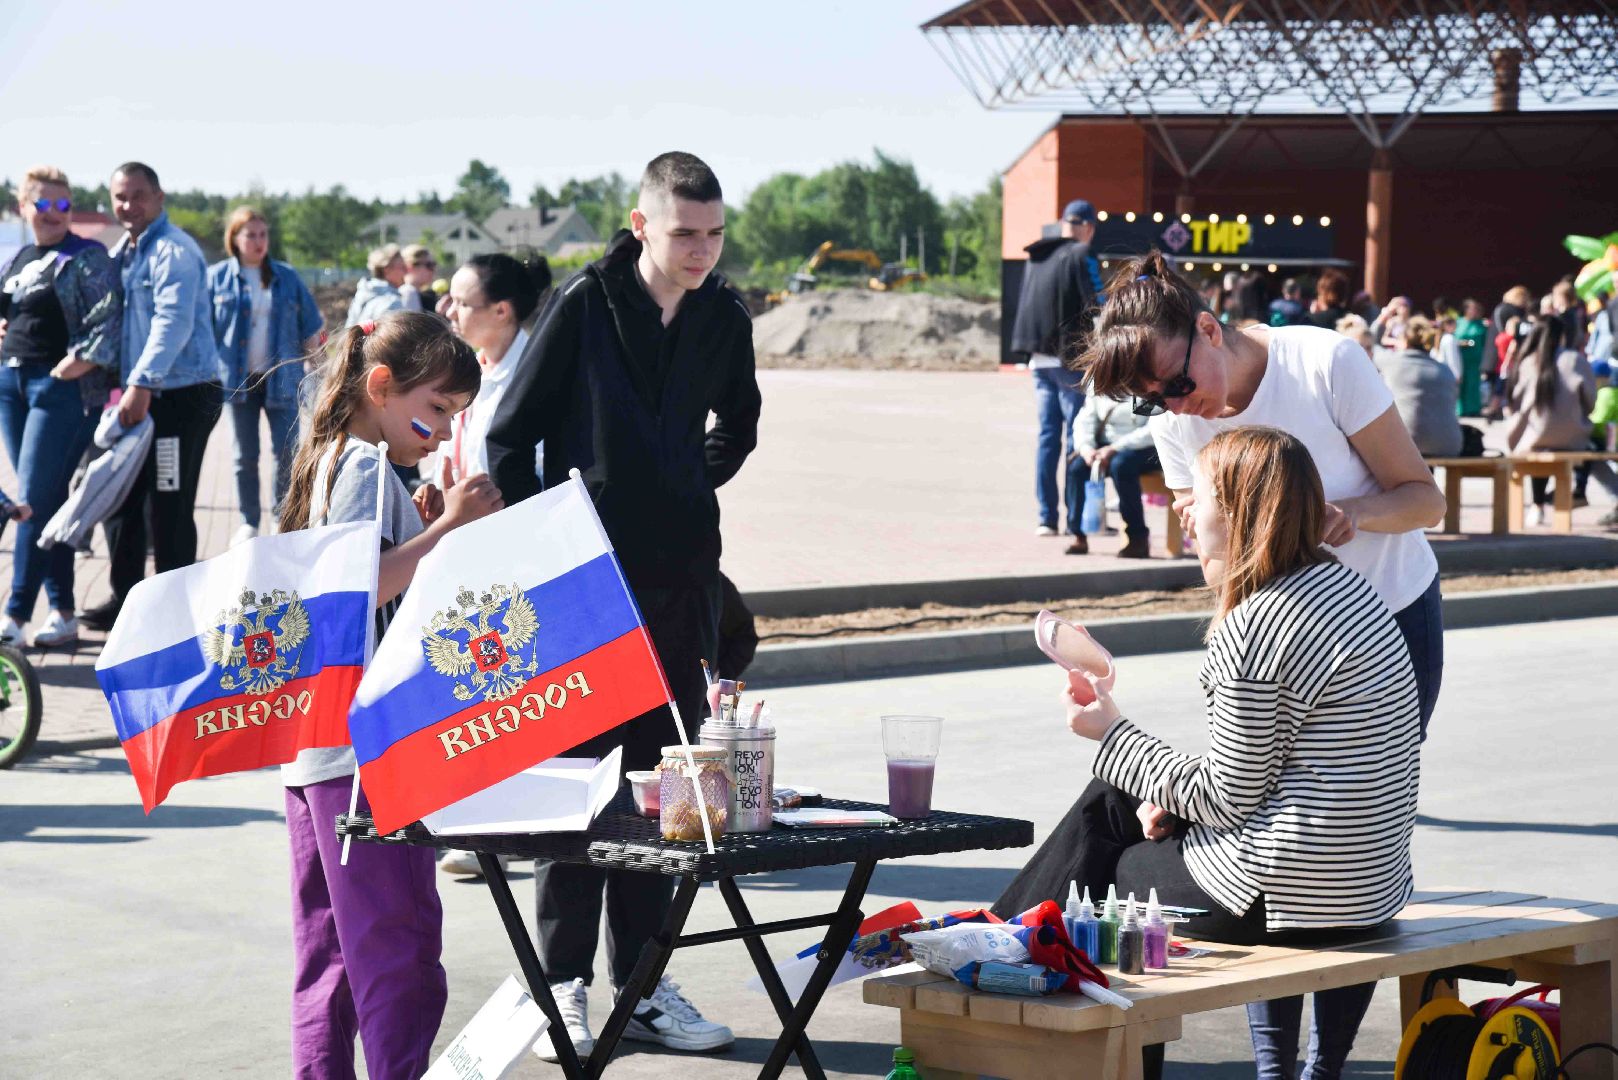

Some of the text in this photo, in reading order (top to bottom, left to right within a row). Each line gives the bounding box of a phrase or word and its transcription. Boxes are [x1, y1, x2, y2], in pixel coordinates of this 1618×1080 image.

[1188, 220, 1251, 254] ТИР
[734, 750, 764, 759] REVO
[739, 758, 760, 766] LUT
[734, 765, 755, 773] ION
[742, 801, 760, 809] ION
